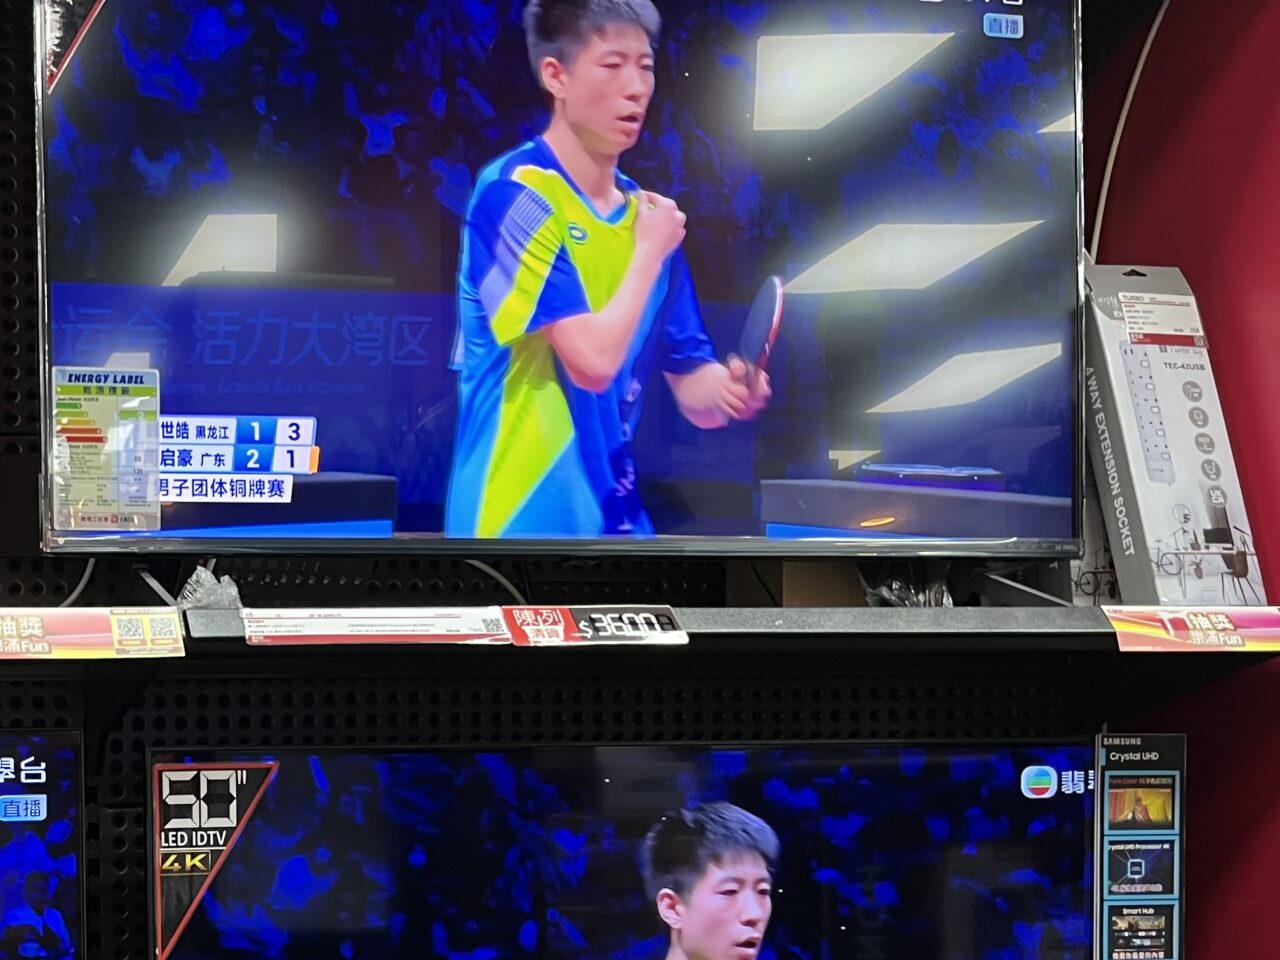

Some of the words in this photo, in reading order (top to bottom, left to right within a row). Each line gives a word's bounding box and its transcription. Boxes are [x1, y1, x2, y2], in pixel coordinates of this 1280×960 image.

[191, 307, 433, 367] 活力大湾区
[67, 373, 110, 384] ENERGY
[112, 374, 145, 385] LABEL
[195, 426, 229, 440] 黑龙江
[250, 422, 261, 441] 1
[287, 422, 301, 441] 3
[200, 453, 226, 468] 广东
[246, 449, 260, 469] 2
[287, 450, 296, 468] 1
[1087, 376, 1103, 409] WAY
[1095, 411, 1121, 495] EXTENSION
[1113, 496, 1136, 556] SOCKET
[157, 478, 285, 498] 男子团体铜牌赛
[512, 609, 564, 626] 陳列
[1103, 737, 1142, 746] SAMSUNG
[1109, 751, 1141, 763] Crystal
[1141, 751, 1159, 761] UHD
[2, 799, 41, 818] 直播
[161, 769, 247, 829] 50"
[160, 830, 188, 847] LED
[192, 829, 227, 847] IDTV
[161, 852, 208, 872] 4K
[1122, 907, 1142, 915] Smart
